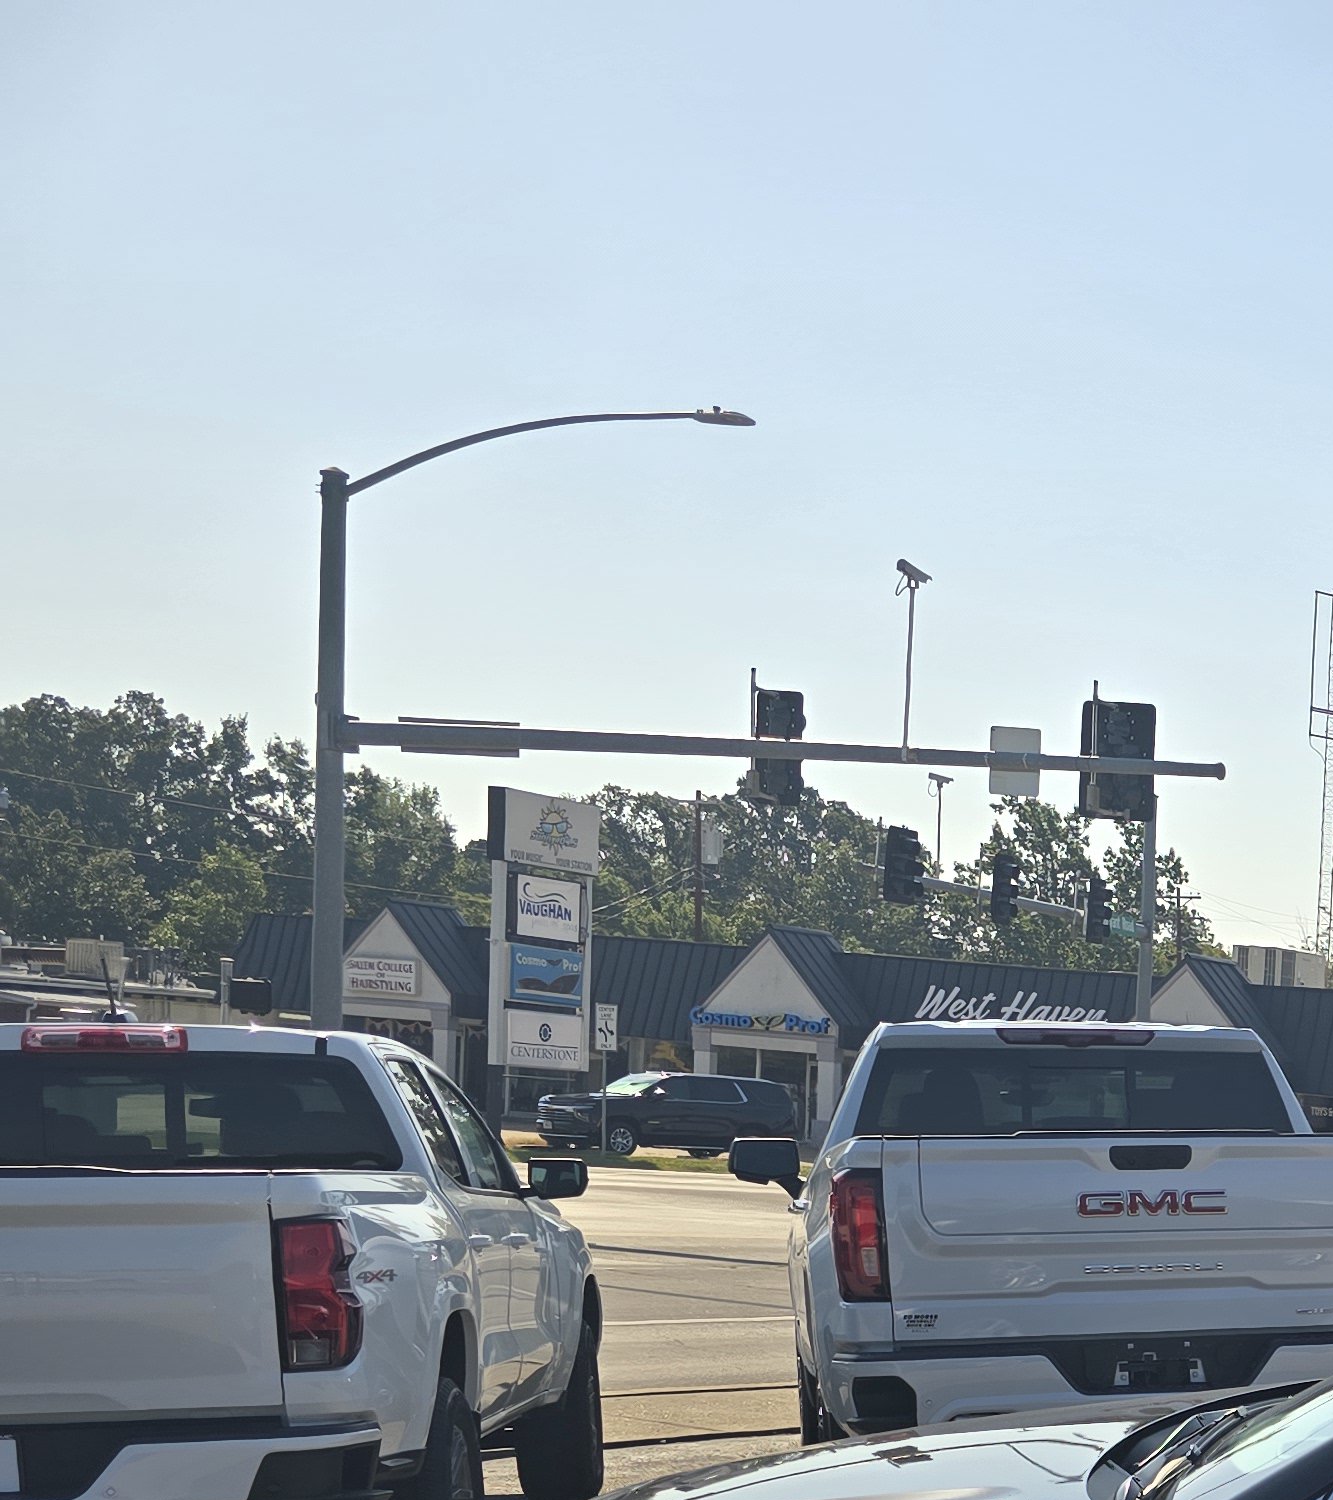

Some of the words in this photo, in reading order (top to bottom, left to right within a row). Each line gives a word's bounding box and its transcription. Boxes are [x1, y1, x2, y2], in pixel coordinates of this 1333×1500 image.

[519, 899, 572, 922] VAUGHAN
[377, 962, 413, 974] COLLEGE
[516, 953, 548, 968] Cosmo
[562, 960, 582, 972] Prof
[351, 977, 412, 993] HAIRSTYLING
[914, 984, 997, 1020] West
[1000, 991, 1109, 1022] Haven
[688, 1005, 754, 1028] Cosmo
[784, 1013, 831, 1035] Prof
[511, 1045, 579, 1062] CENTERSTONE
[1077, 1189, 1229, 1218] GMC
[1084, 1262, 1224, 1274] DENALI
